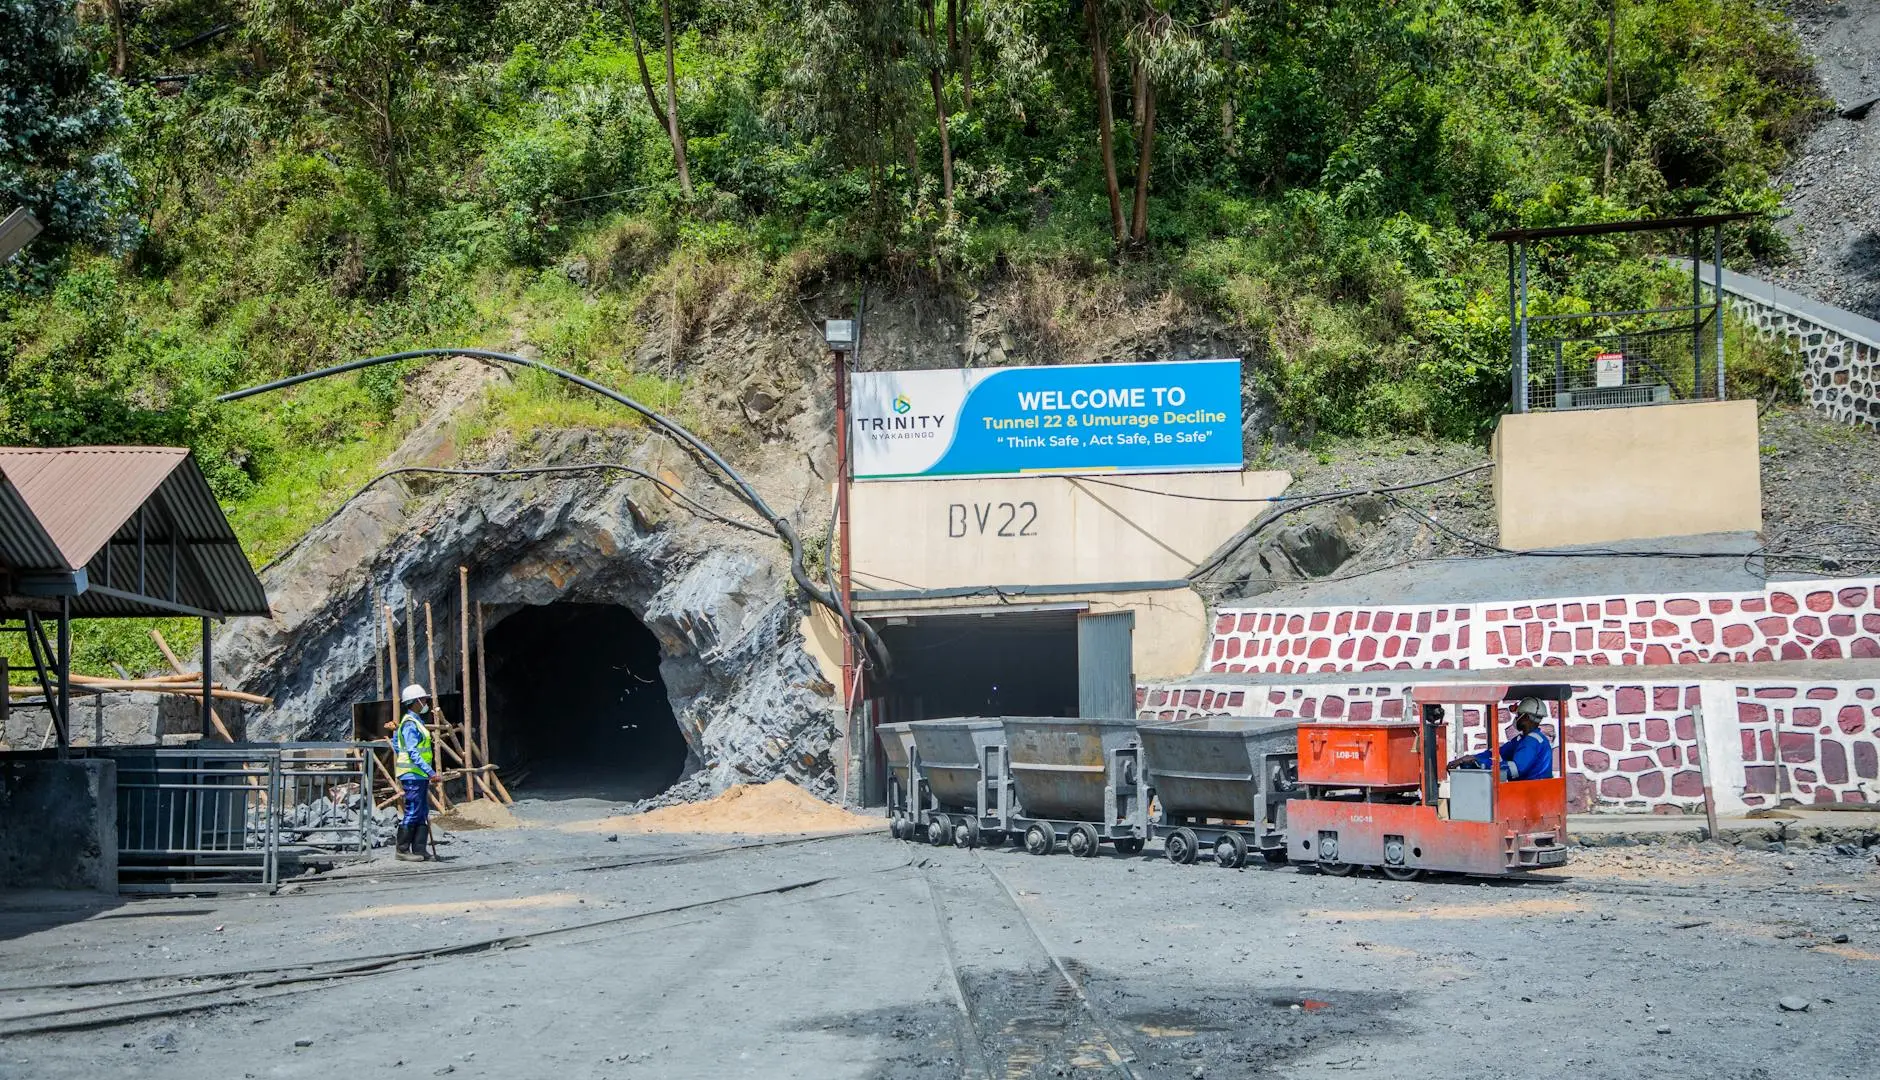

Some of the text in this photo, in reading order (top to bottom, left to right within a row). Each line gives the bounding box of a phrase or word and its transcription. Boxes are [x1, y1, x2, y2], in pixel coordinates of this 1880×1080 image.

[1017, 386, 1186, 411] WELCOME TO
[857, 415, 945, 431] TRINITY
[982, 409, 1227, 430] Tunnel 22 & Umurage Decline
[871, 431, 935, 441] NYAKABINGO
[1006, 435, 1047, 448] Think
[1049, 435, 1080, 447] Safe
[1089, 433, 1114, 446] Act
[1116, 432, 1151, 446] Safe,
[1154, 432, 1173, 444] Be
[949, 501, 1038, 538] BV22
